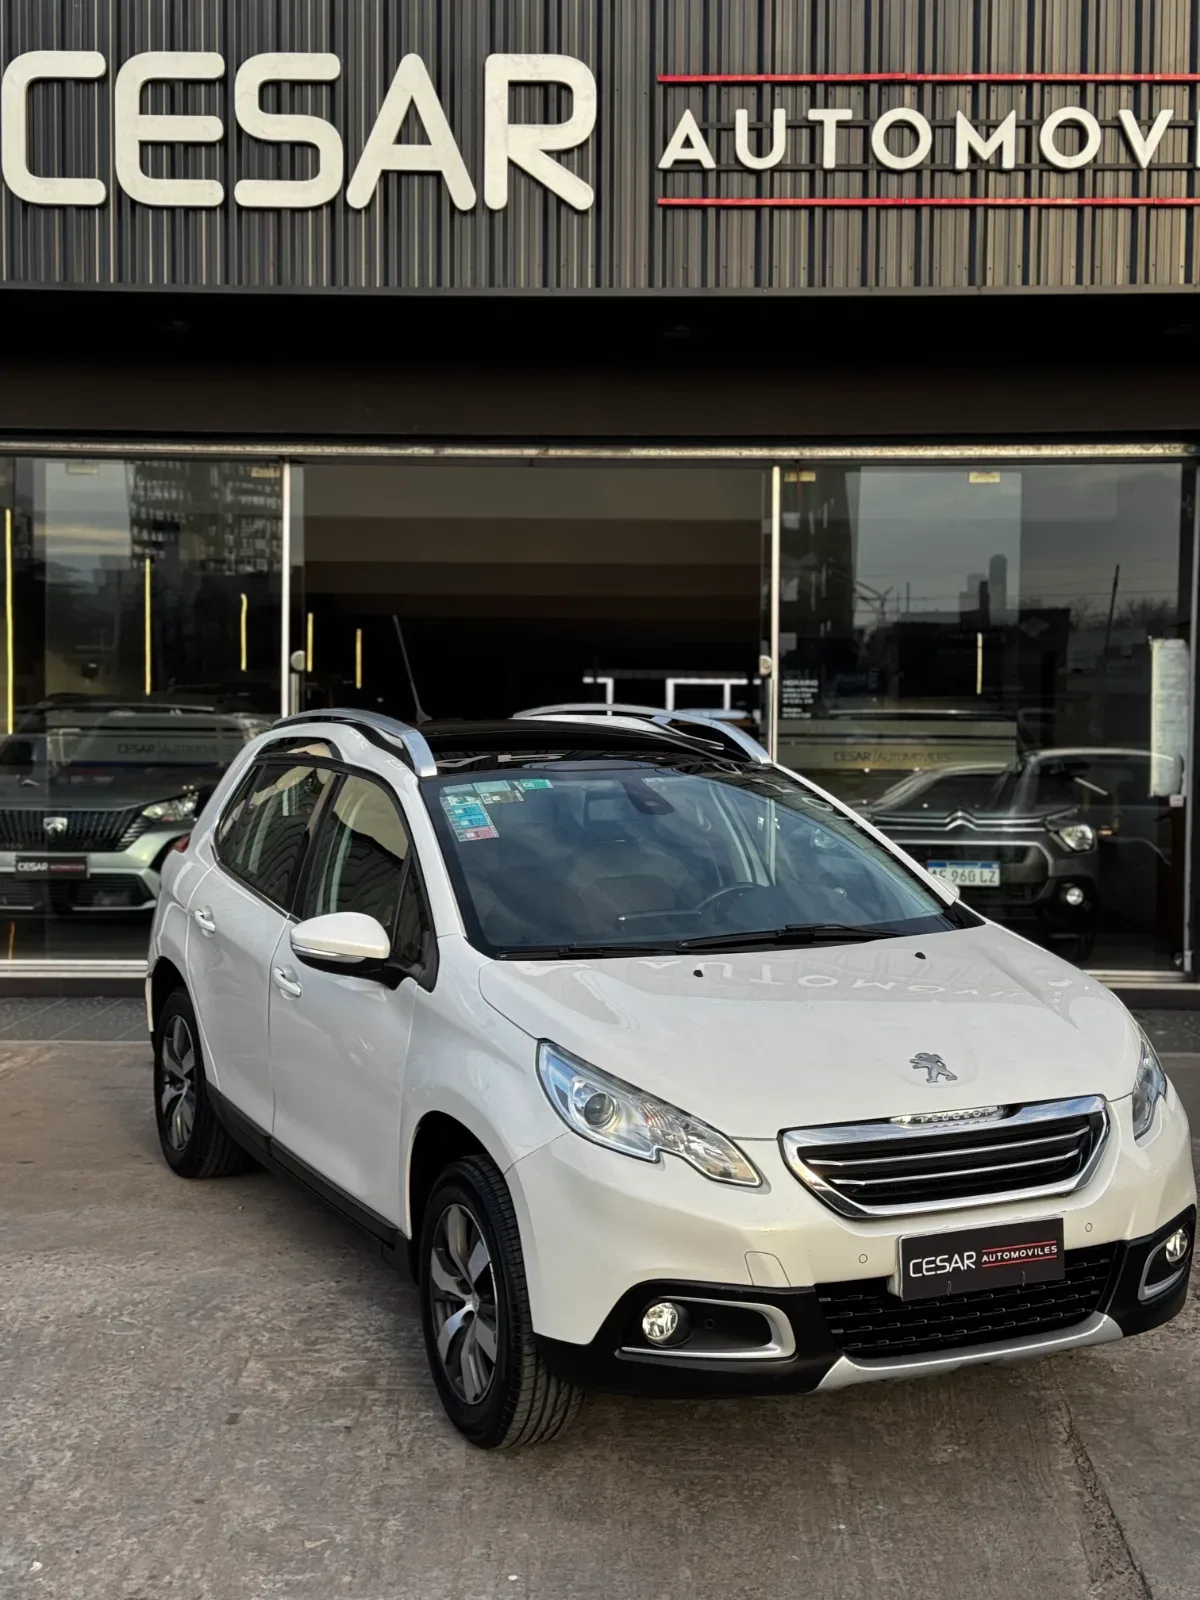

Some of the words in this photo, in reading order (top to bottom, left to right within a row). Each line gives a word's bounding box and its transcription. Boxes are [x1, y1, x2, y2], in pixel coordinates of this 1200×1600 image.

[1, 51, 597, 211] CESAR
[657, 107, 1200, 170] AUTOMOV
[833, 751, 872, 762] CESAR
[951, 870, 976, 883] 960
[980, 870, 996, 883] LZ
[920, 1108, 990, 1123] PEUGEOT
[909, 1251, 977, 1278] CESAR
[981, 1245, 1058, 1263] AUTOMOVILES
